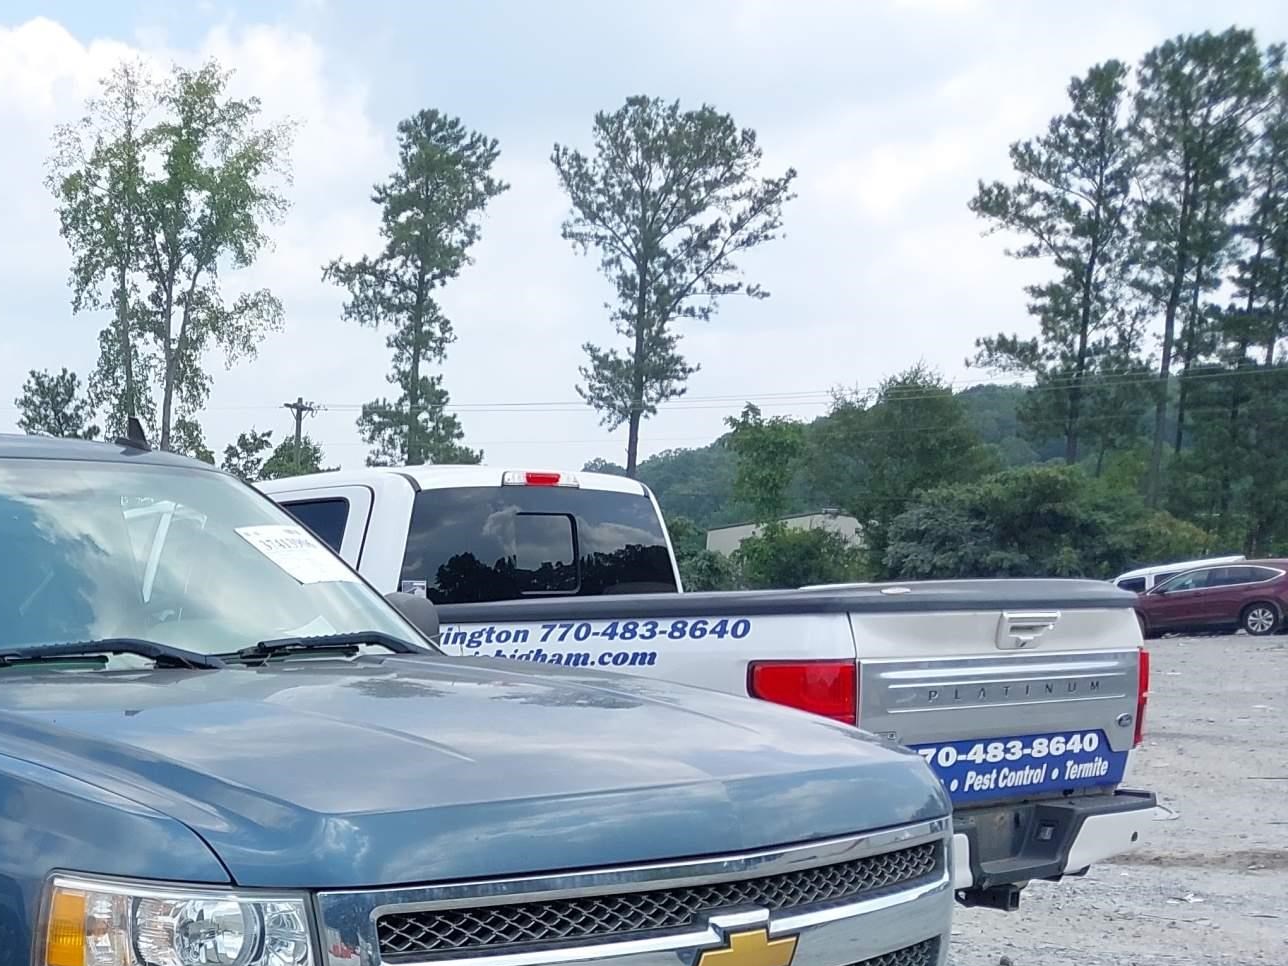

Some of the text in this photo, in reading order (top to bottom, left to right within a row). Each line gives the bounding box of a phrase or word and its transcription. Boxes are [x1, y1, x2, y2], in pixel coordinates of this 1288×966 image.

[540, 618, 751, 643] 770-483-8640
[928, 680, 1101, 702] PLATINUM
[914, 732, 1099, 768] 70-483-8640
[963, 756, 1109, 793] Pest Control Termite
